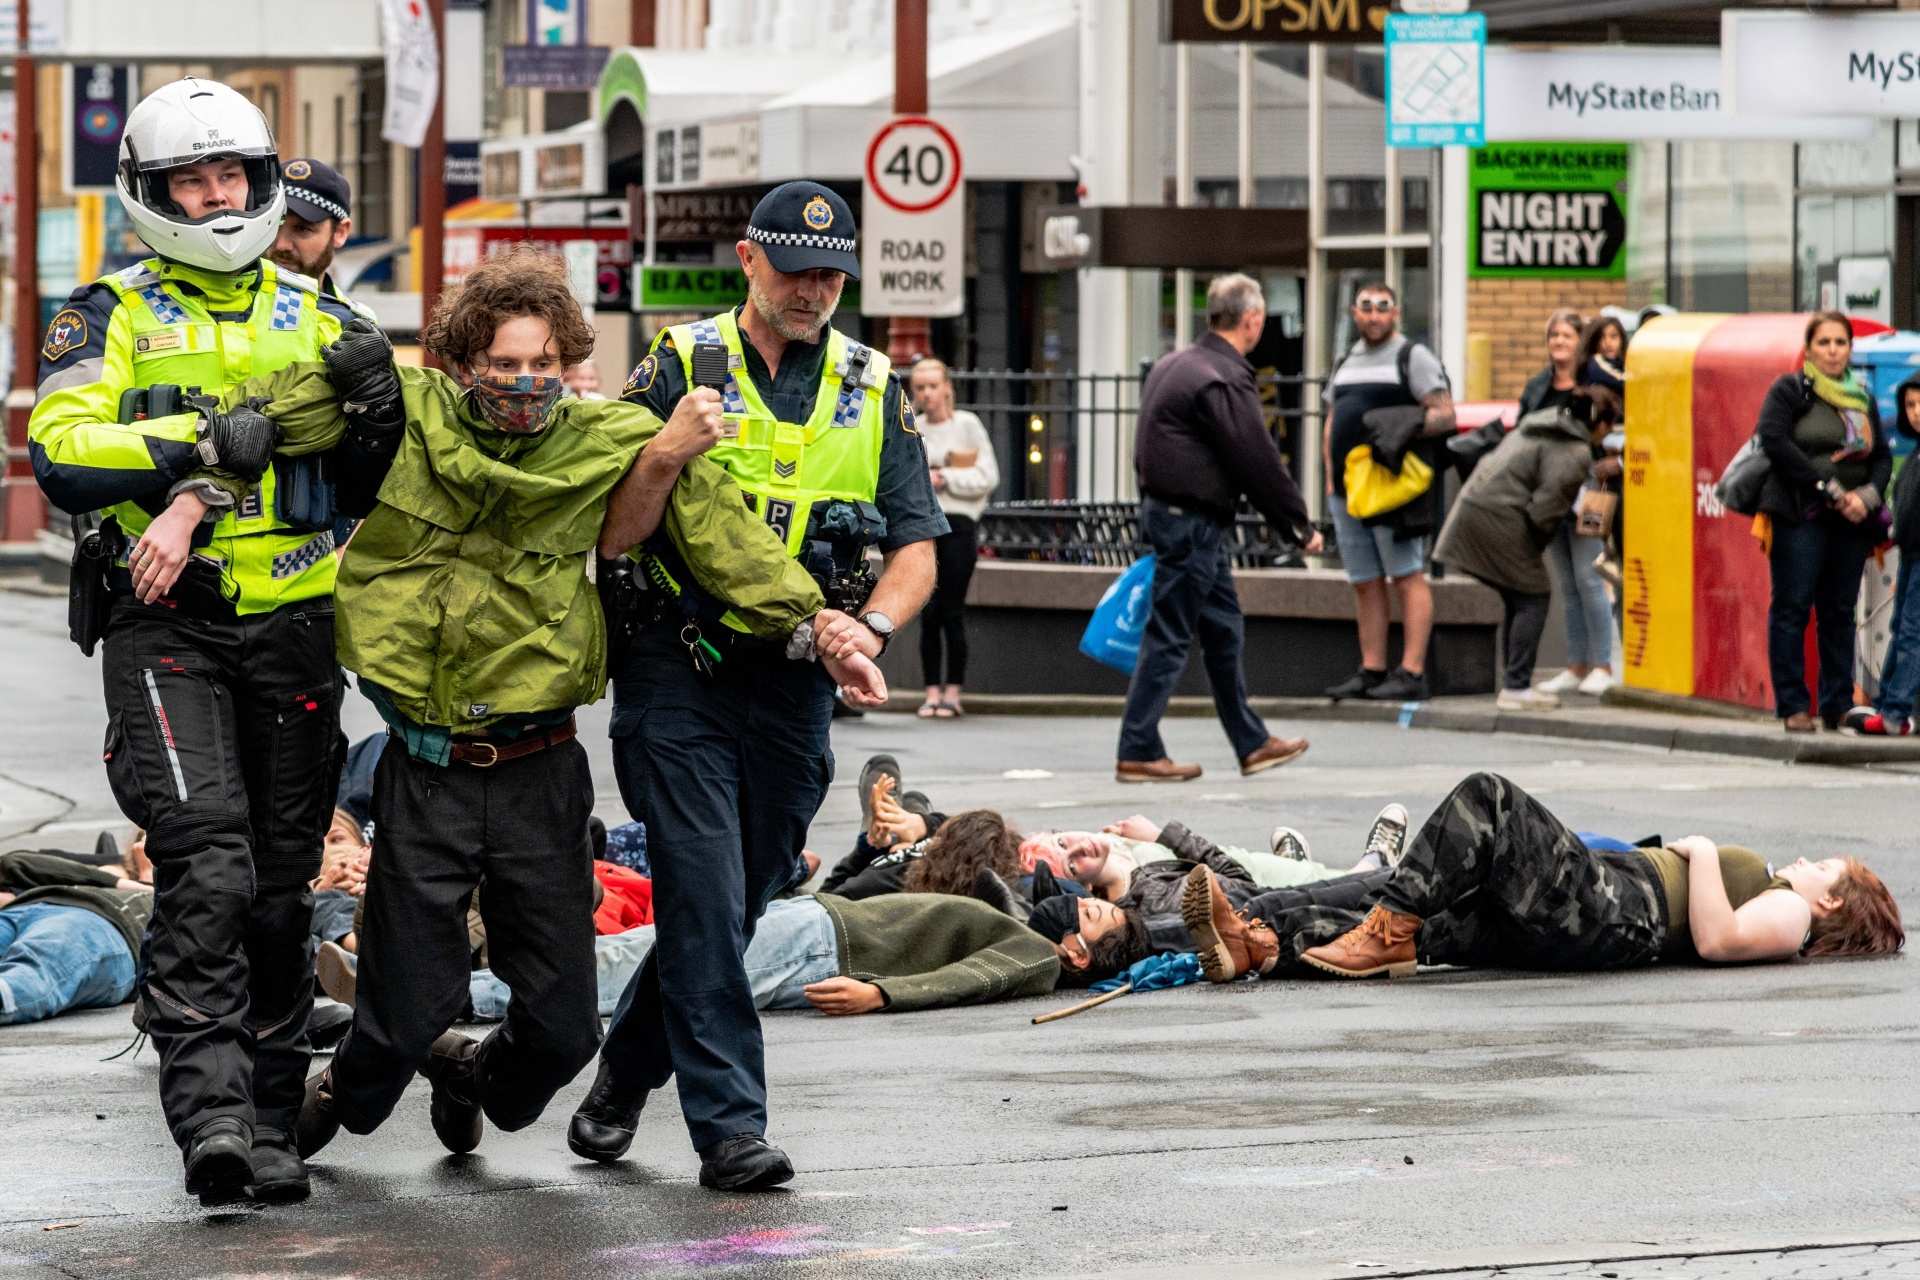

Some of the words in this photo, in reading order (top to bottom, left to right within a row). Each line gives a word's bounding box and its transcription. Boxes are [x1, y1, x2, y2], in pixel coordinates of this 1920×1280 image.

[1203, 0, 1361, 31] OPSM
[192, 139, 237, 151] SHARK
[884, 144, 944, 186] 40
[1482, 192, 1608, 230] NIGHT
[881, 241, 945, 262] ROAD
[1482, 231, 1607, 266] ENTRY
[880, 271, 945, 291] WORK
